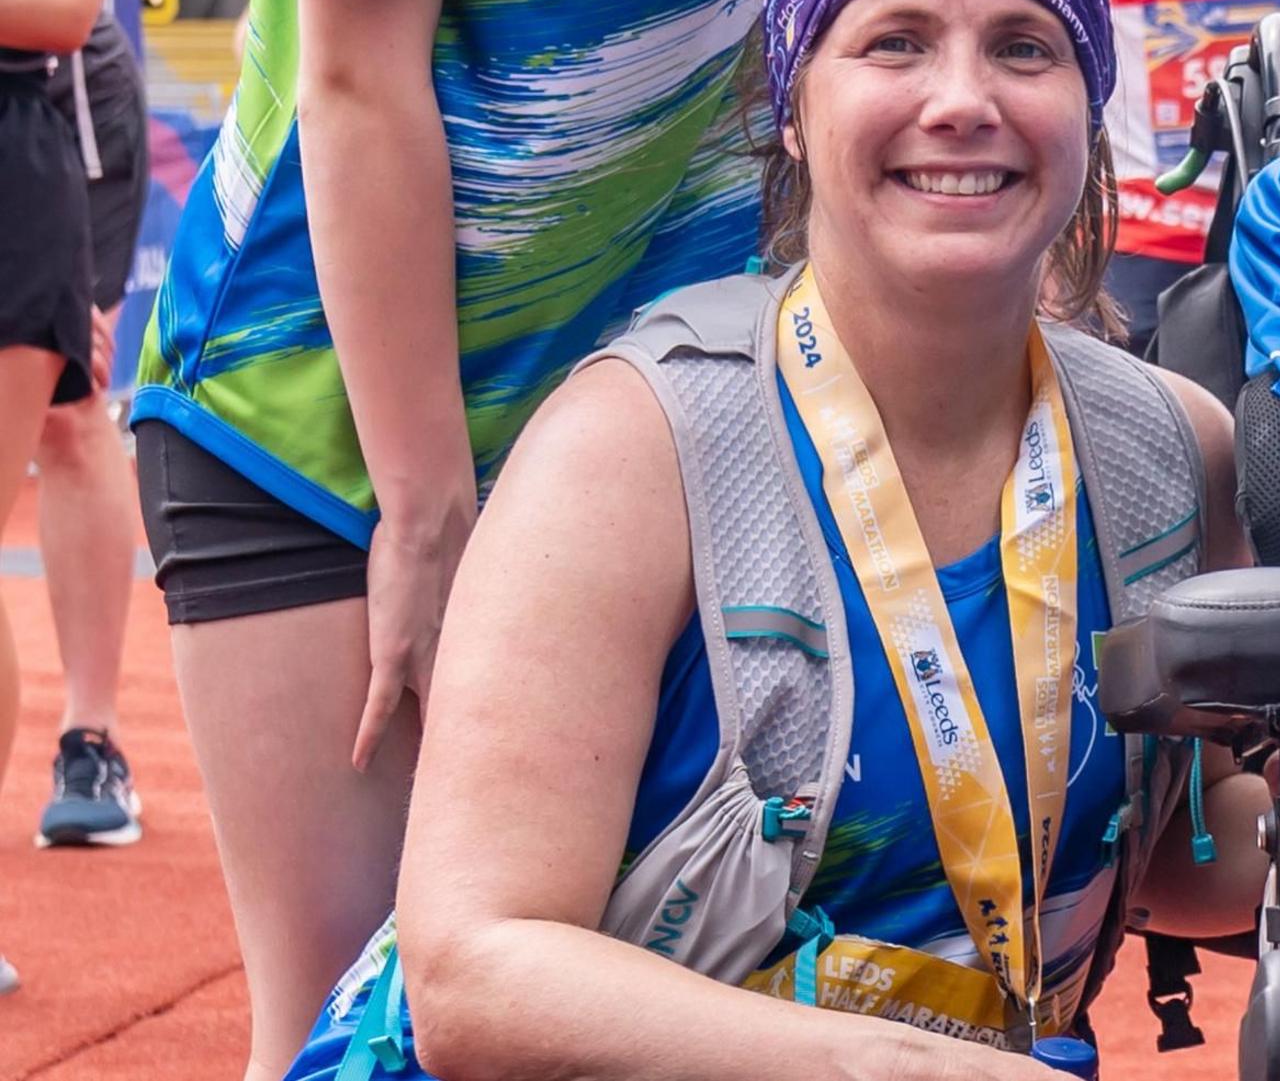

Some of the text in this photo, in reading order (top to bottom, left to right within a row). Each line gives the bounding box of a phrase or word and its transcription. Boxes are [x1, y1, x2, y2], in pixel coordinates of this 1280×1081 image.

[794, 307, 823, 369] 2024
[1023, 420, 1042, 484] Leeds
[851, 490, 898, 591] MARATHON
[1045, 576, 1060, 678] MARATHON
[925, 679, 958, 746] Leeds
[820, 981, 880, 1016] HALF
[825, 955, 896, 992] LEEDS
